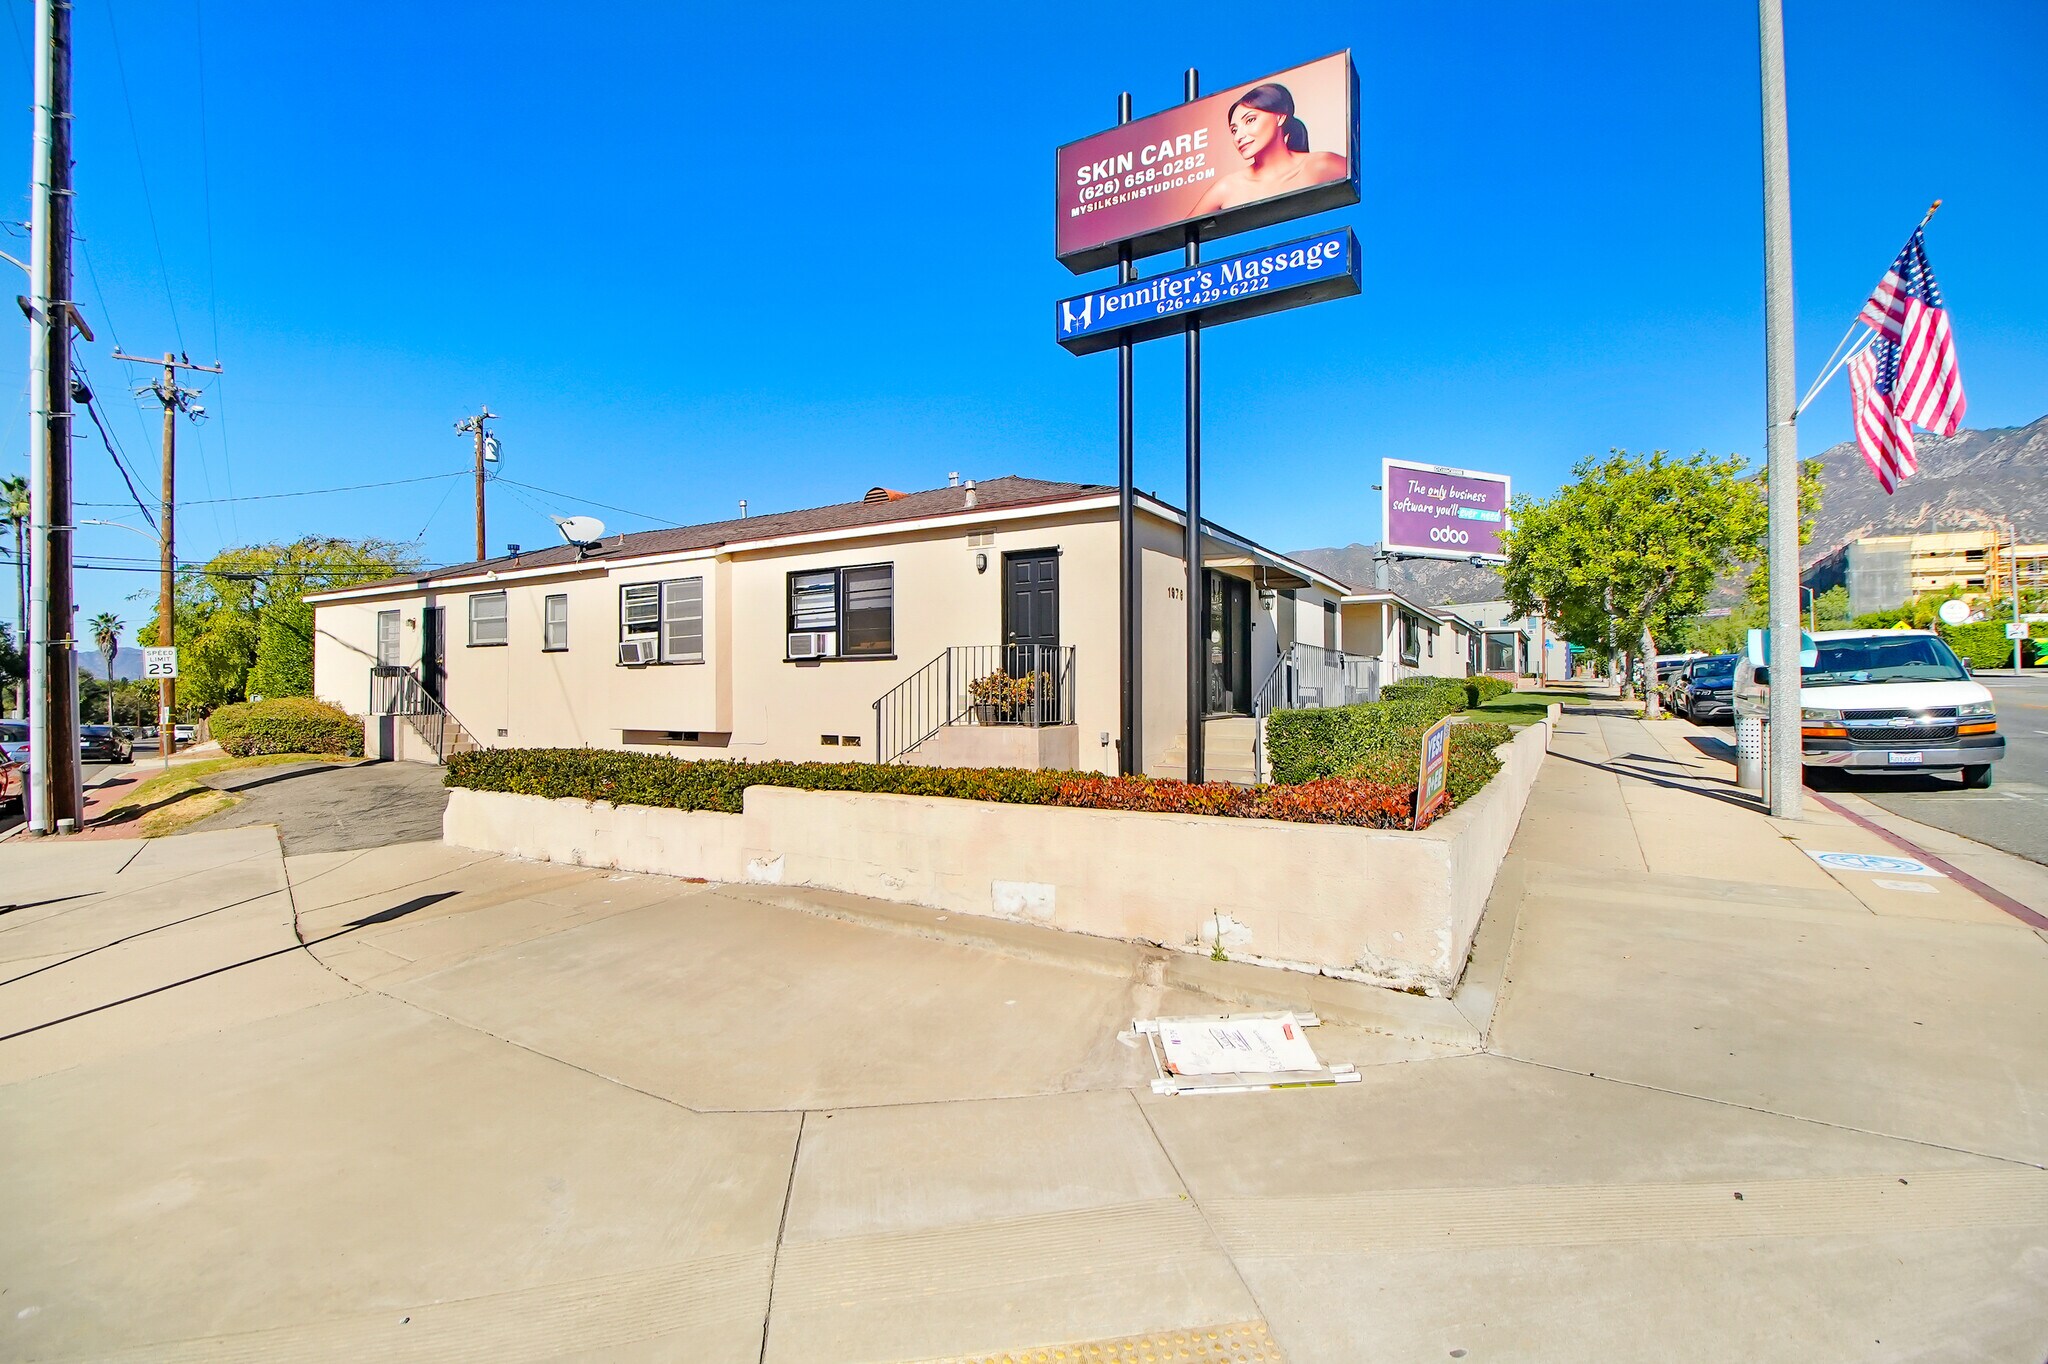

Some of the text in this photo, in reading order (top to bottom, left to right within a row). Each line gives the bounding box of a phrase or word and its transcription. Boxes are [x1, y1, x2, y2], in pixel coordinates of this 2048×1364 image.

[1076, 128, 1209, 186] SKIN CARE
[1071, 167, 1215, 218] MYSILKSKINSTUDIO.COM
[1079, 153, 1206, 203] (626) 658-0282
[1098, 240, 1340, 319] Jennifer's Massage
[1392, 497, 1433, 513] software
[1434, 503, 1459, 518] you'll
[1408, 480, 1487, 503] The only business
[1430, 525, 1469, 545] odoo
[149, 663, 173, 675] 25
[1428, 730, 1443, 762] YES!
